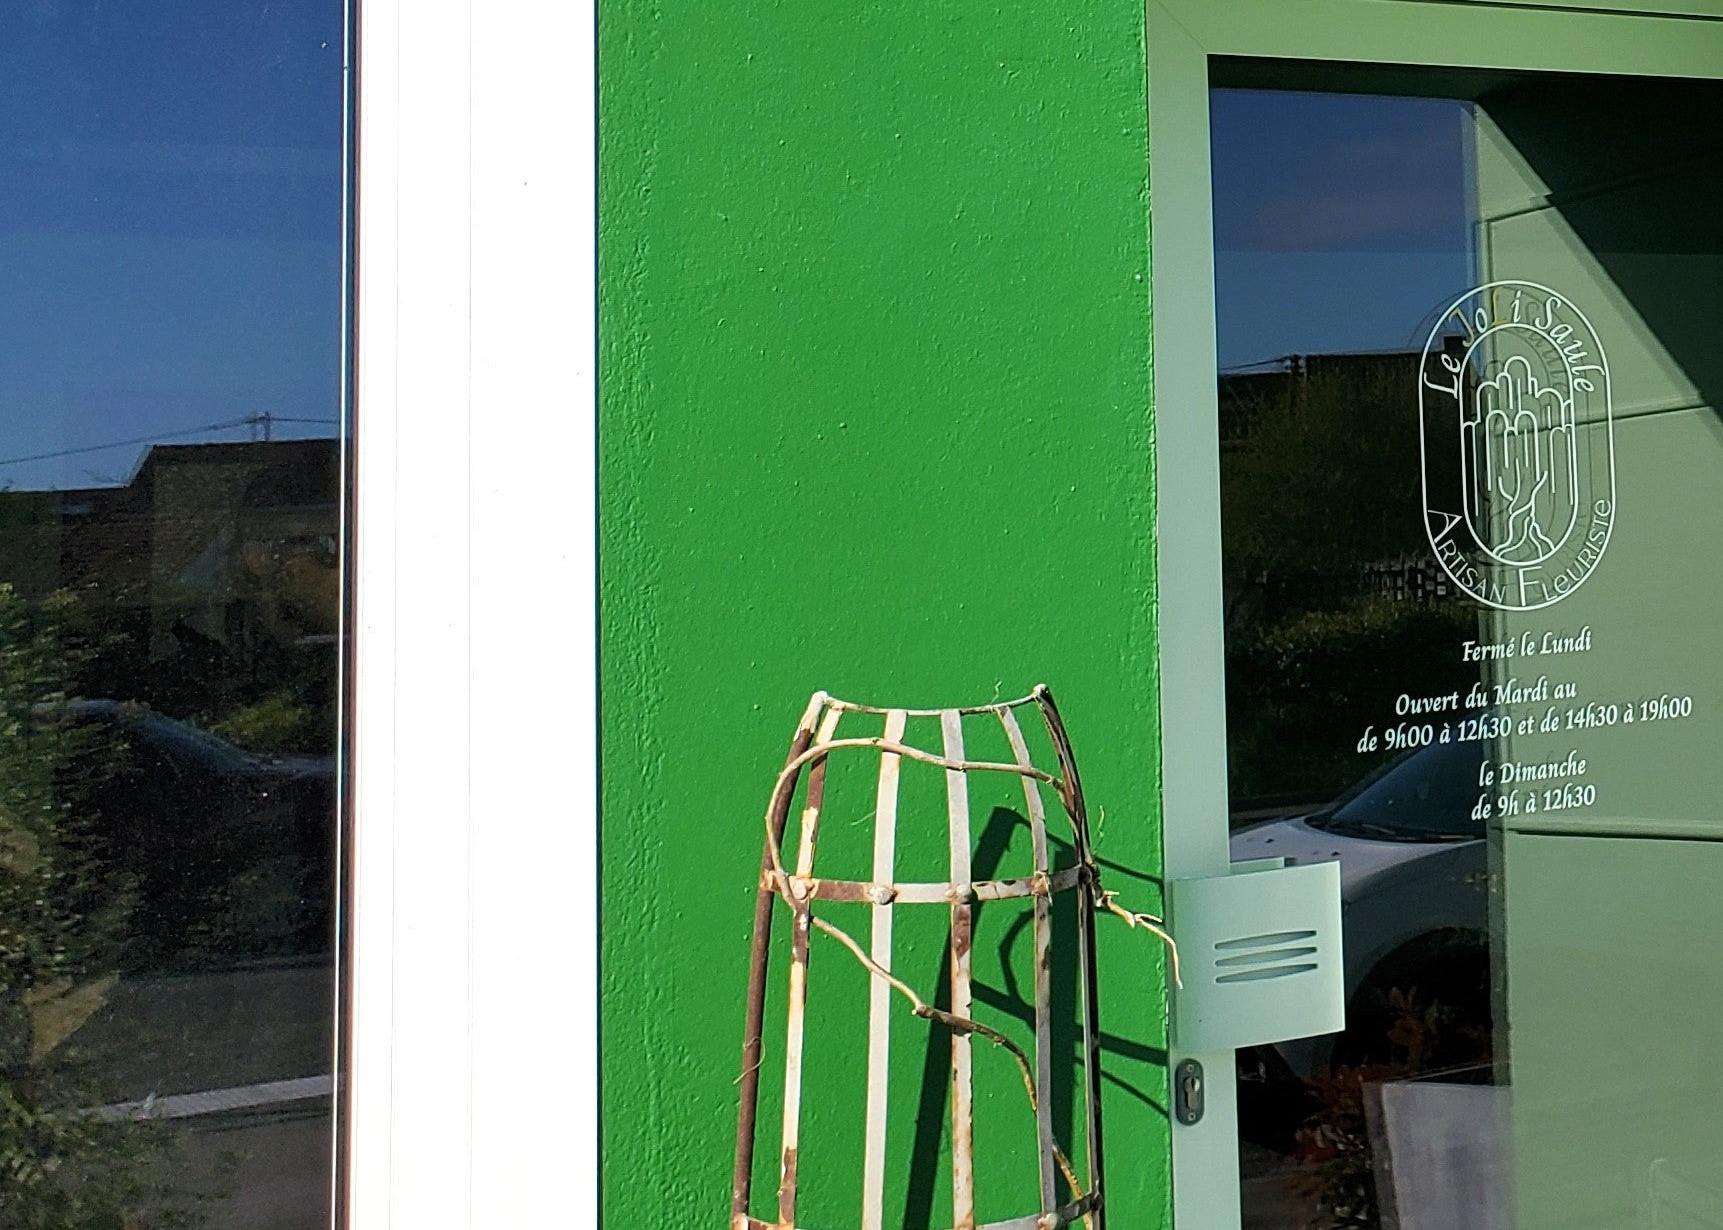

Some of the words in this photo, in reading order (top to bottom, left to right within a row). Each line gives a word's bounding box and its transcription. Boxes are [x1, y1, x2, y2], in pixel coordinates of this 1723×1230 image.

[1424, 353, 1461, 399] Le
[1535, 296, 1606, 393] Saule
[1462, 636, 1517, 662] Fermé
[1520, 631, 1536, 657] le
[1540, 626, 1592, 655] Lundi
[1395, 690, 1459, 716] Ouvert
[1464, 682, 1489, 709] du
[1493, 675, 1549, 705] Mardi
[1554, 679, 1578, 700] au
[1357, 725, 1379, 754] de
[1384, 723, 1434, 750] 9h00
[1439, 722, 1452, 744] à
[1457, 715, 1512, 743] 12h30
[1518, 717, 1535, 736] et
[1539, 714, 1560, 734] de
[1565, 704, 1619, 731] 14h30
[1623, 703, 1635, 724] à
[1640, 696, 1693, 722] 19h00
[1478, 761, 1495, 788] le
[1499, 749, 1587, 785] Dimanche
[1471, 792, 1493, 821] de
[1497, 792, 1520, 818] 9h
[1525, 792, 1538, 814] à
[1543, 784, 1597, 813] 12h30
